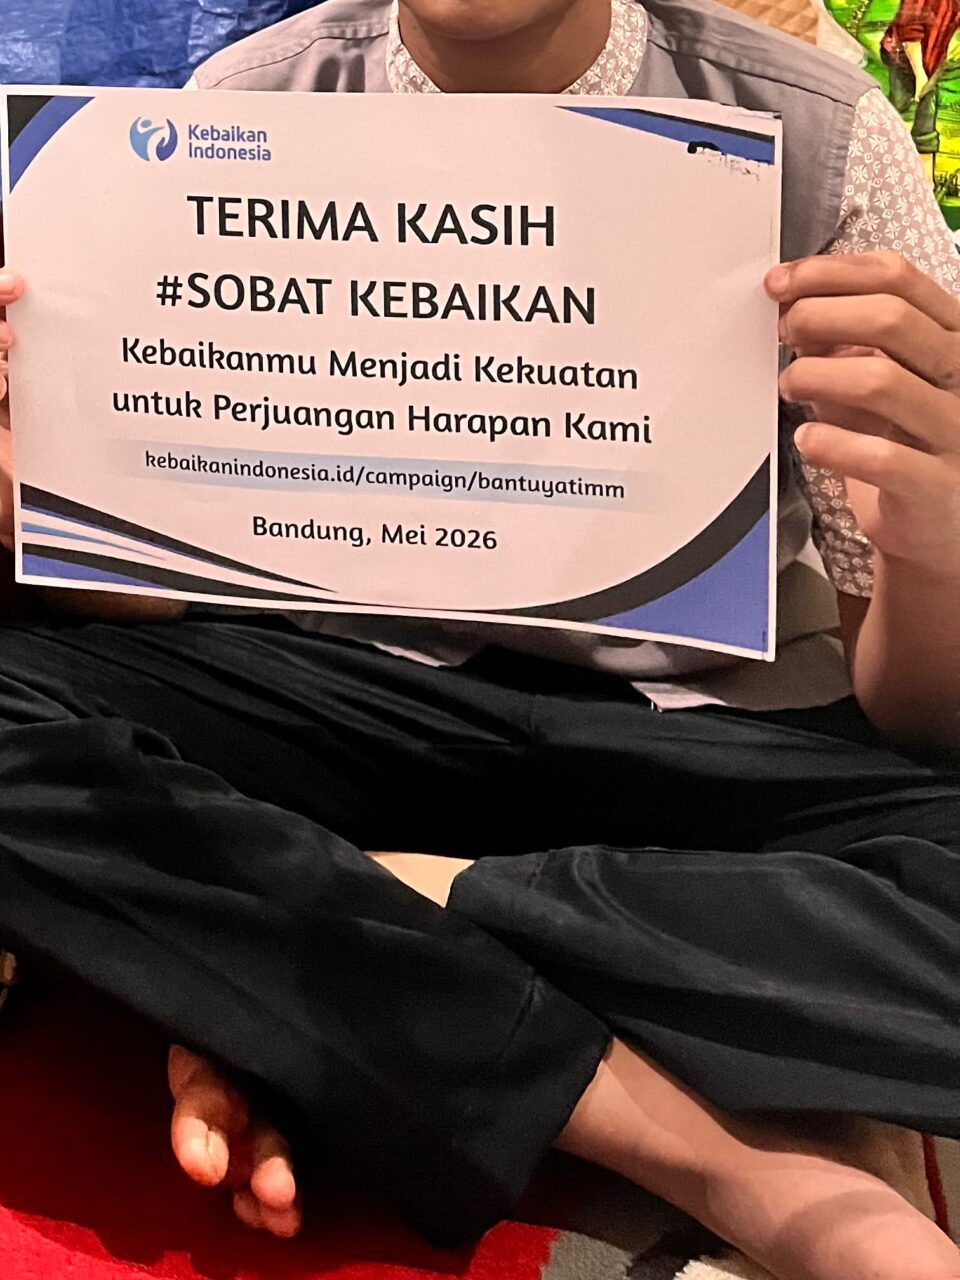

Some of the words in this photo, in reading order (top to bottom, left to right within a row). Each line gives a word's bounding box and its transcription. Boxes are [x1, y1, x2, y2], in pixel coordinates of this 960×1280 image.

[188, 123, 268, 143] Kebaikan
[188, 142, 272, 161] Indonesia
[187, 196, 378, 242] TERIMA
[398, 203, 554, 246] KASIH
[156, 273, 332, 314] #SOBAT
[351, 280, 594, 324] KEBAIKAN
[123, 338, 316, 375] Kebaikanmu
[330, 350, 462, 386] Menjadi
[475, 356, 637, 389] Kekuatan
[113, 391, 202, 418] untuk
[214, 394, 394, 435] Perjuangan
[409, 405, 550, 442] Harapan
[566, 413, 652, 443] Kami
[146, 450, 624, 498] kebaikanindonesia.id/campaign/bantuyatimm
[253, 516, 371, 547] Bandung,
[382, 524, 426, 545] Mei
[436, 528, 497, 549] 2026
